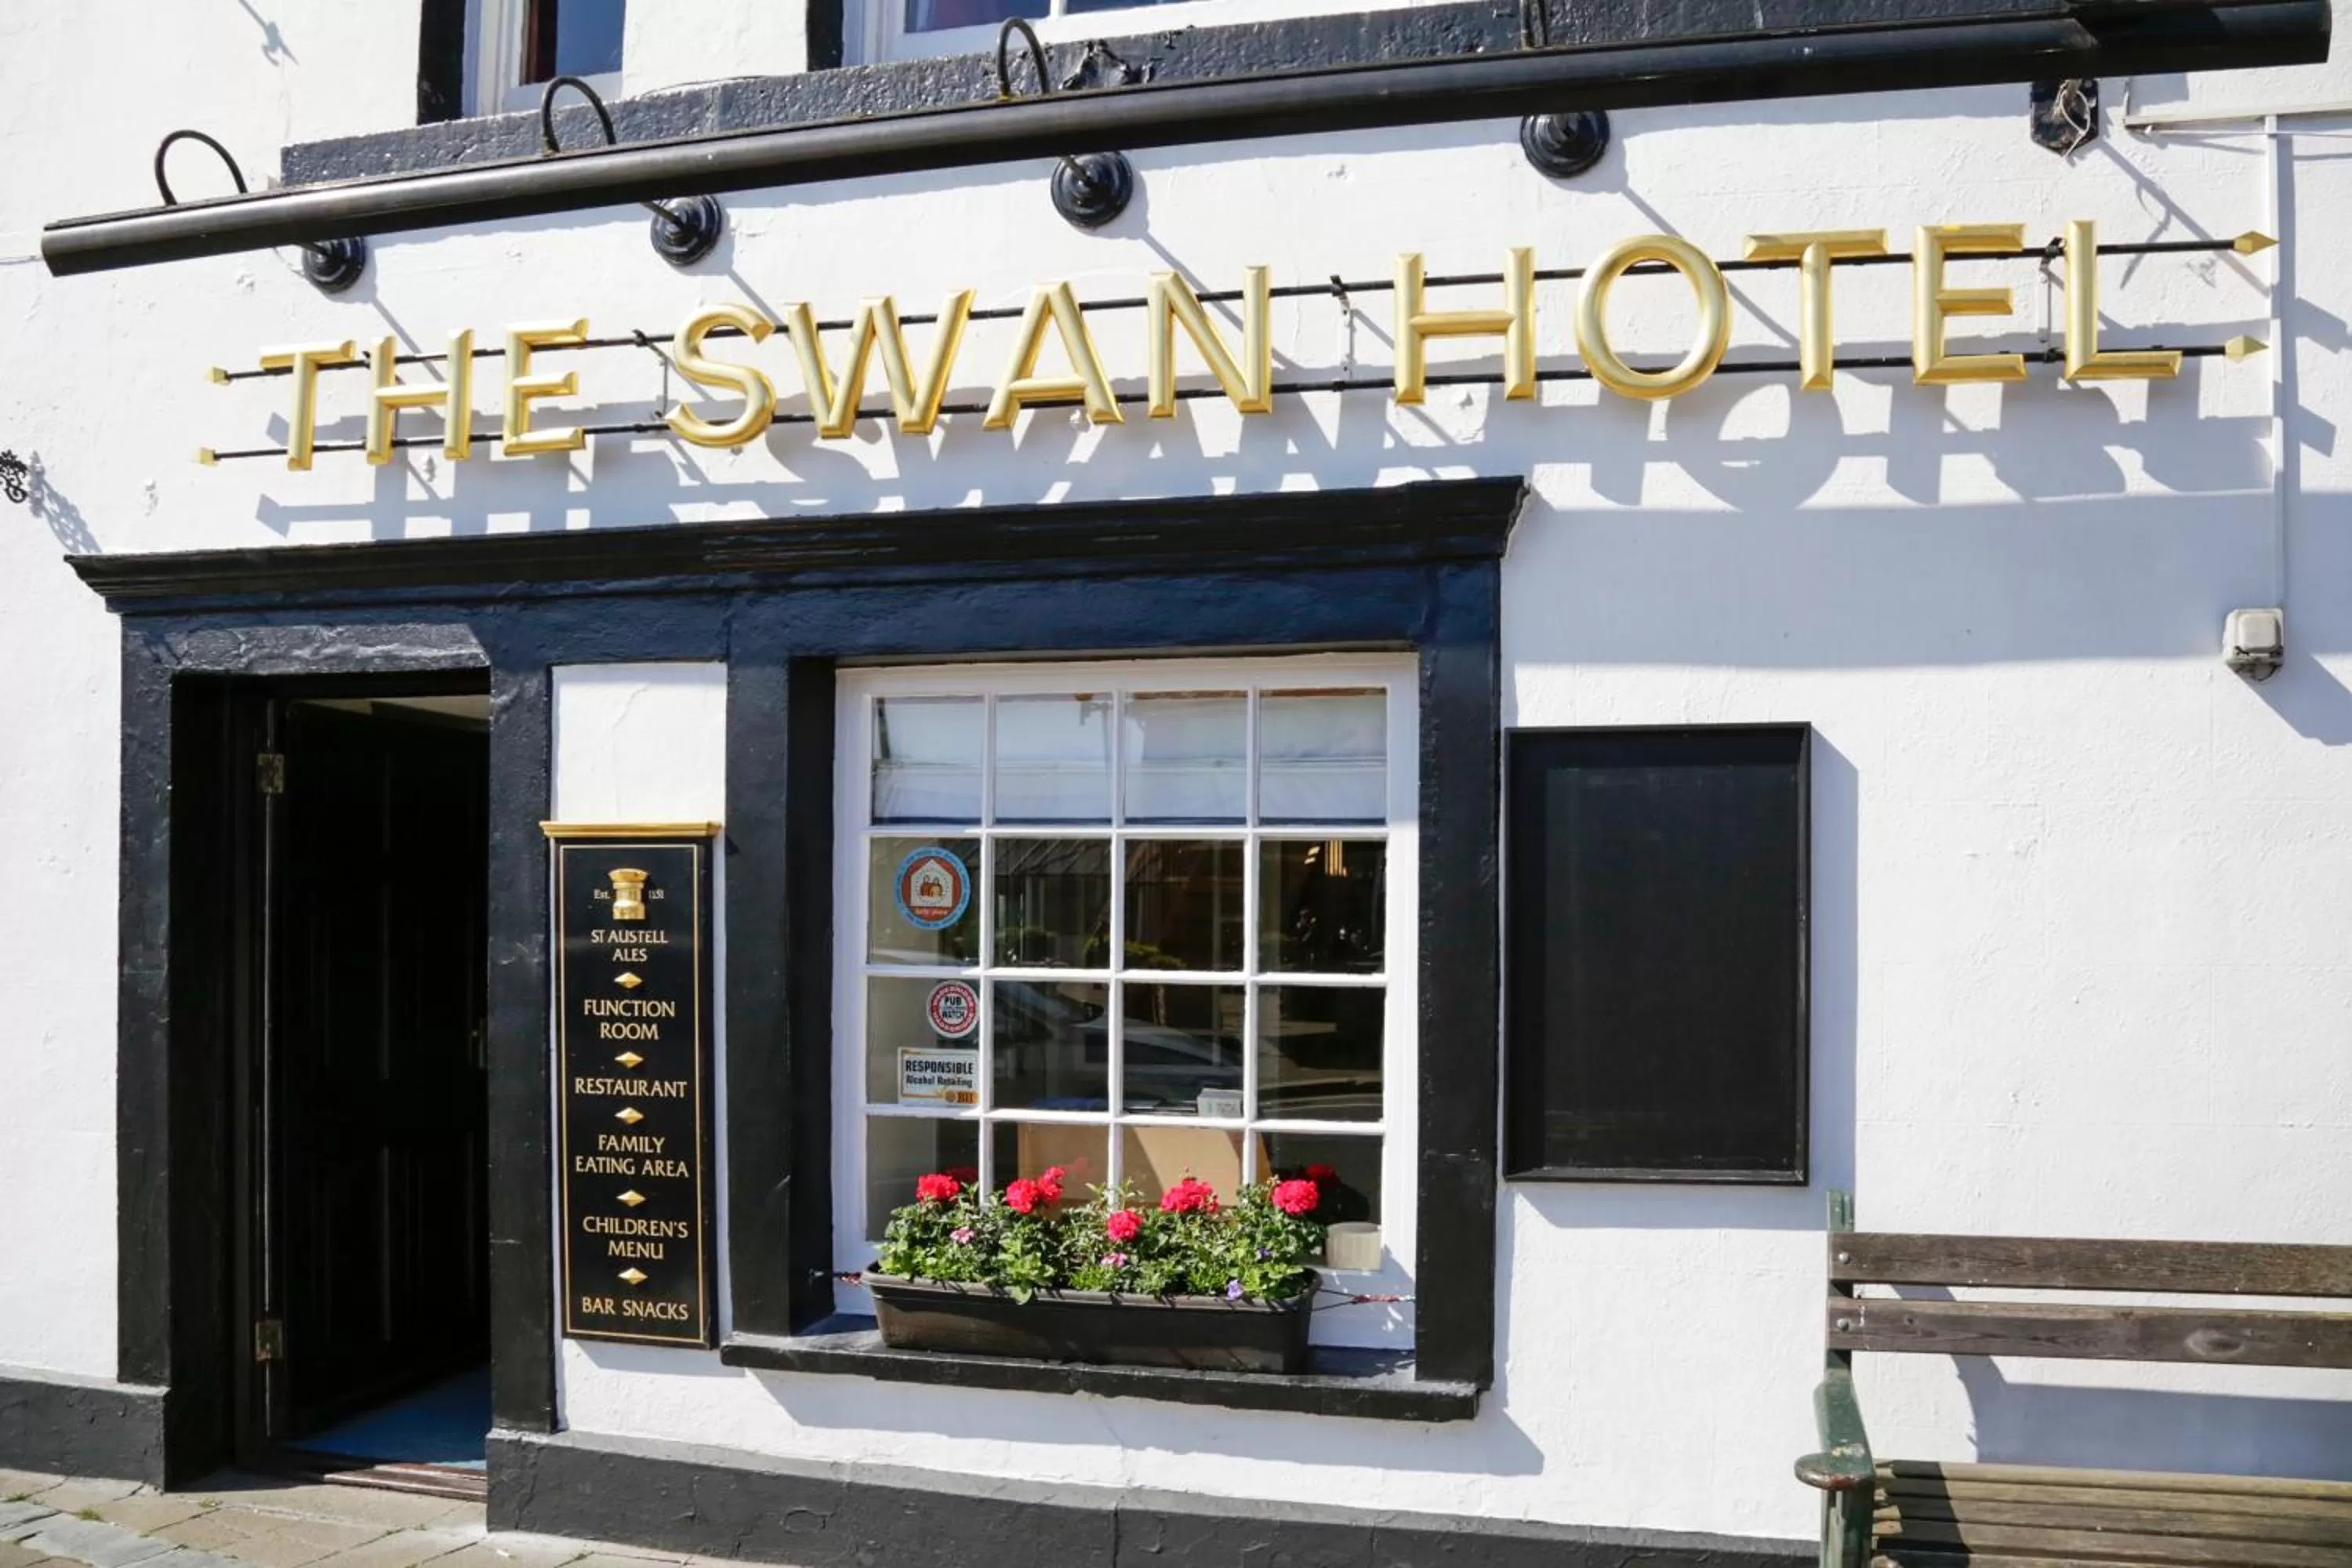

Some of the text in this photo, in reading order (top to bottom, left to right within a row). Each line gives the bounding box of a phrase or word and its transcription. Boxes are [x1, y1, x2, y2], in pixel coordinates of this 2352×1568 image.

[259, 220, 2183, 470] THE SWAN HOTEL
[591, 930, 668, 943] ST AUSTELL
[613, 949, 647, 961] ALES
[585, 1000, 674, 1016] FUNCTION
[944, 996, 962, 1006] PUB
[601, 1022, 659, 1040] ROOM
[906, 1060, 974, 1074] RESPONSIBLE
[575, 1078, 687, 1098] RESTAURANT
[599, 1135, 665, 1152] FAMILY
[576, 1156, 688, 1177] EATING AREA
[583, 1217, 688, 1237] CHILDREN'S
[608, 1240, 662, 1259] MENU
[583, 1297, 688, 1319] BAR SNACKS
